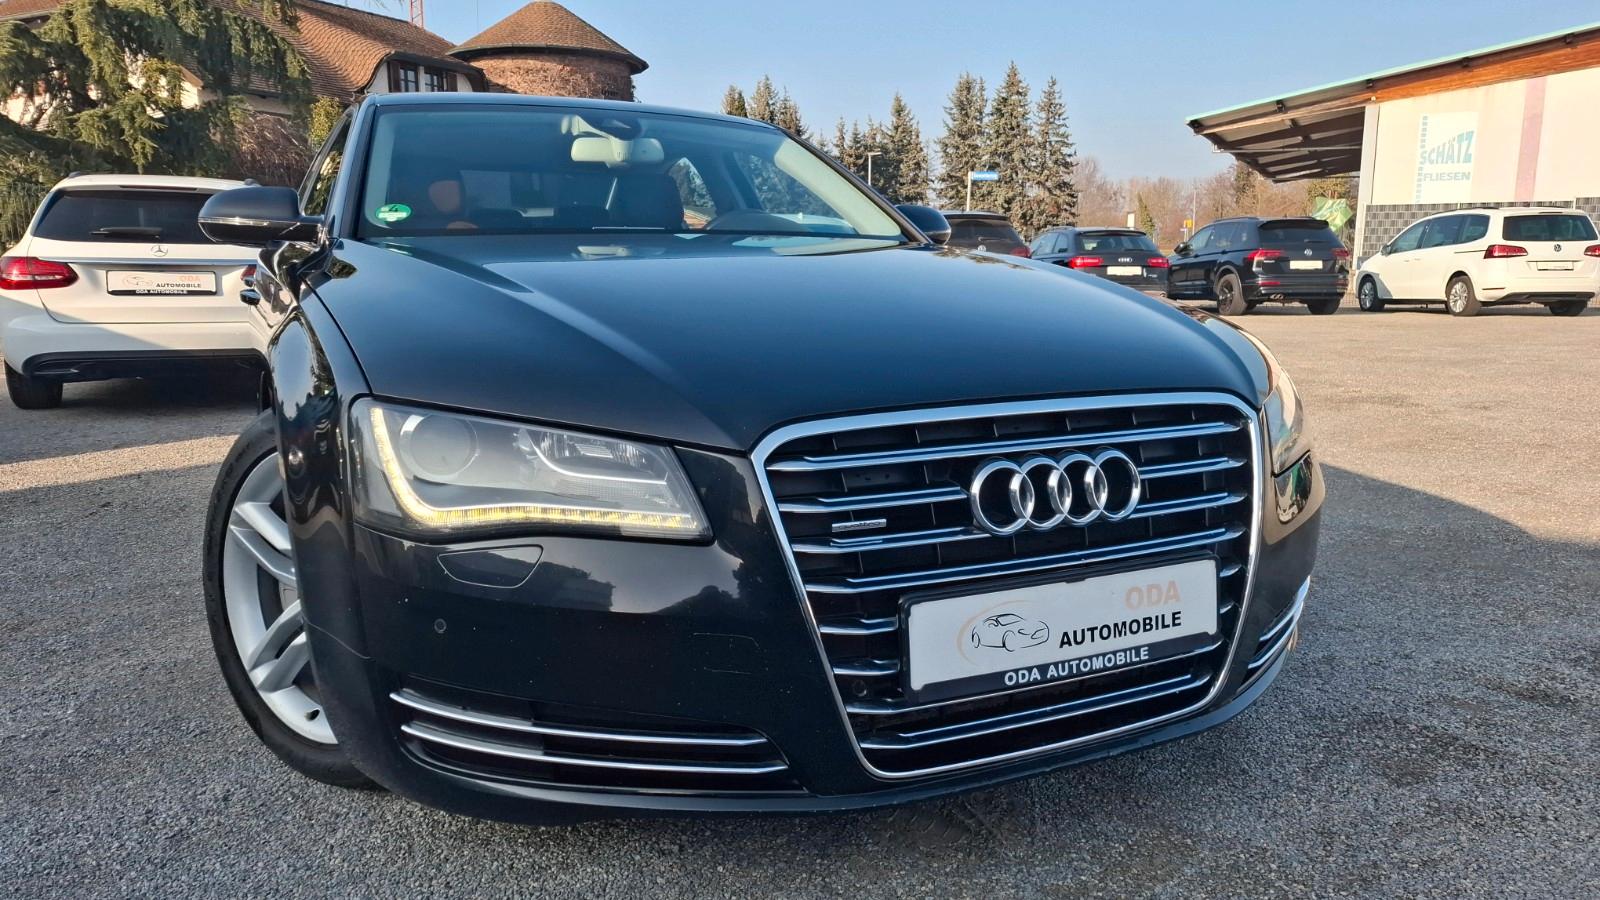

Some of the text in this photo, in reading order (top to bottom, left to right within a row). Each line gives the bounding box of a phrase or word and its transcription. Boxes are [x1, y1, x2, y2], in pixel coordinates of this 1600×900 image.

[1420, 130, 1474, 164] SCHÄTZ
[1423, 171, 1471, 181] FLIESEN
[1125, 580, 1181, 610] ODA
[1059, 611, 1182, 648] AUTOMOBILE
[1004, 646, 1149, 686] ODA AUTOMOBILE
